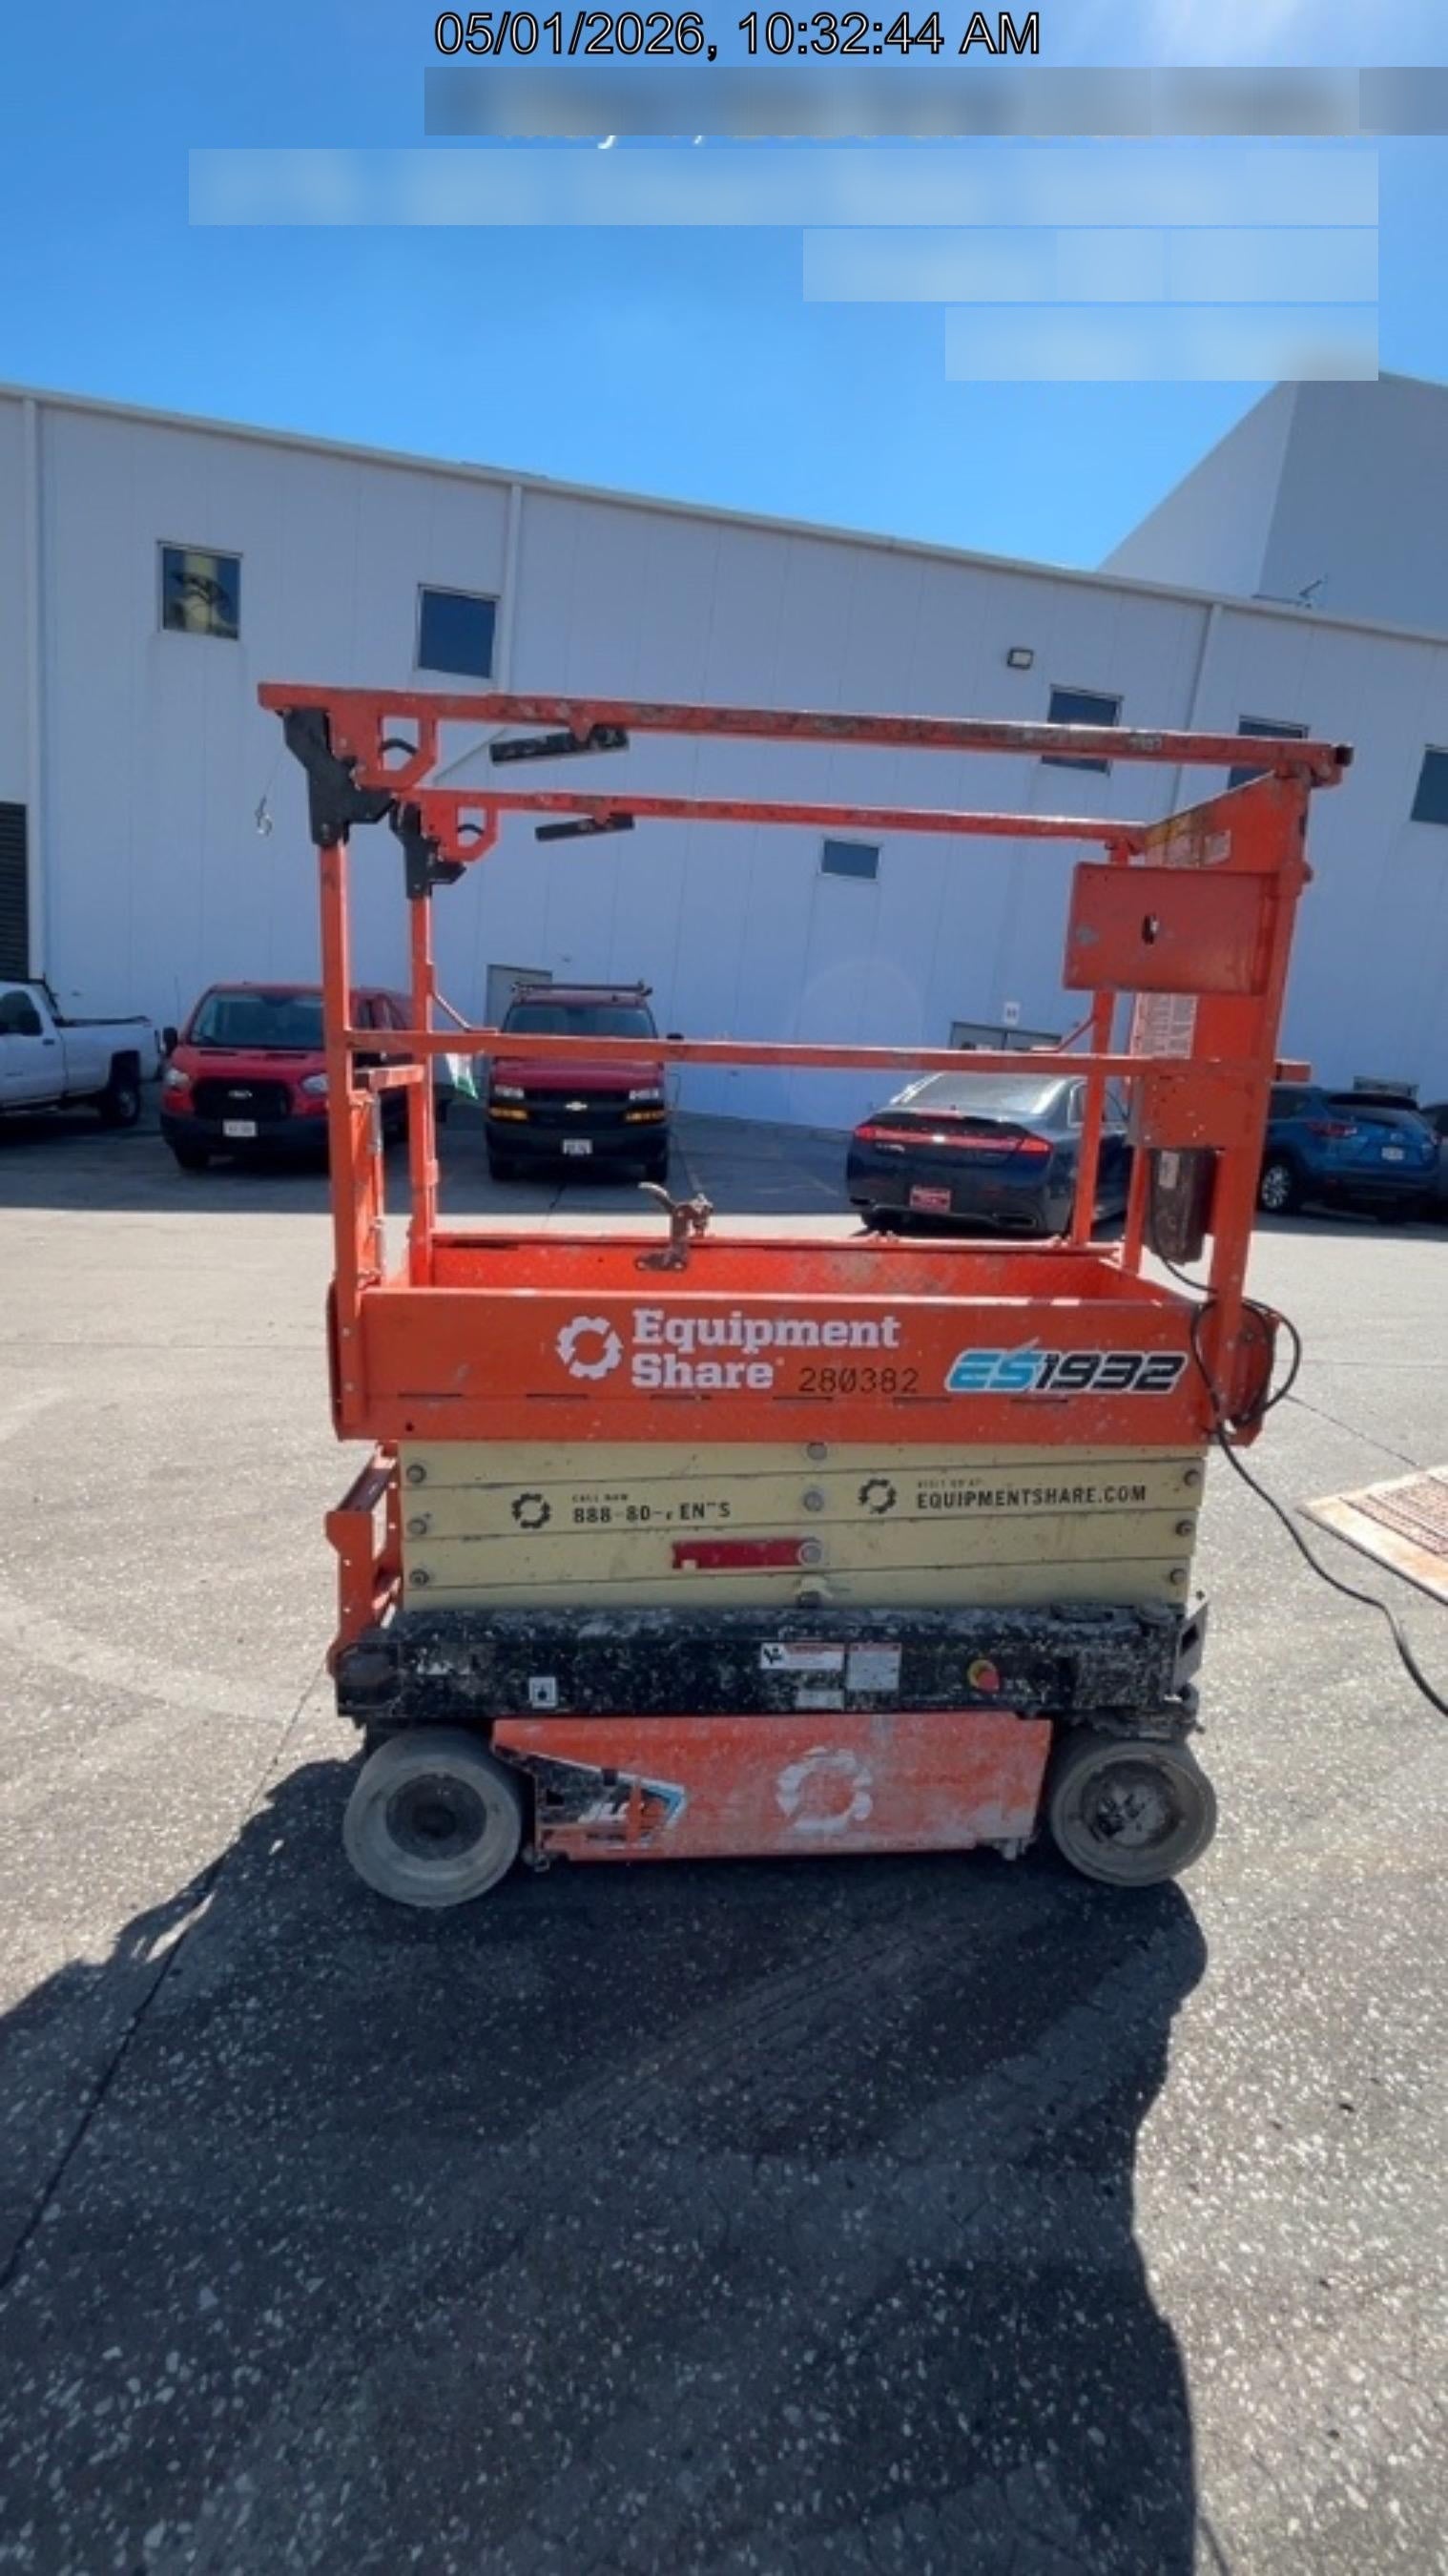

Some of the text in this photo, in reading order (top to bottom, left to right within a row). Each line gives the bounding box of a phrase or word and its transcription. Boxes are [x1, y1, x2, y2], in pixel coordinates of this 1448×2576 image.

[631, 1308, 901, 1355] Equipment
[631, 1352, 775, 1390] Share
[798, 1366, 921, 1395] 280382
[944, 1340, 1189, 1395] ES1932
[573, 1501, 732, 1525] 888-80-ENS
[917, 1485, 1148, 1510] EQUIPMENTSHARE.COM
